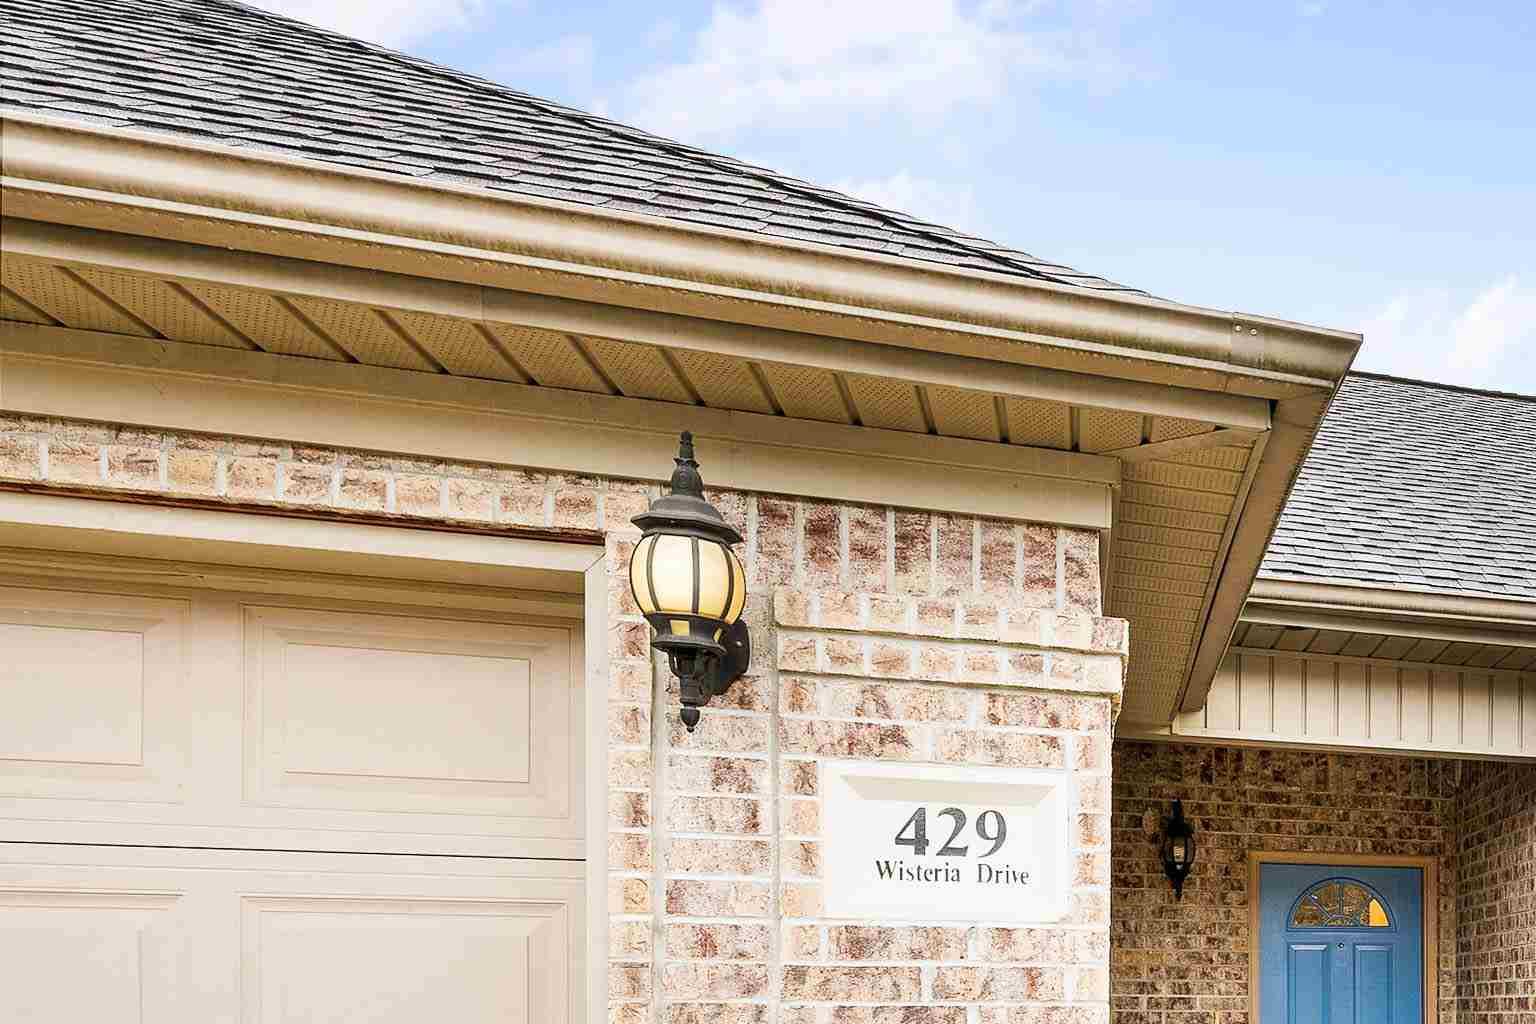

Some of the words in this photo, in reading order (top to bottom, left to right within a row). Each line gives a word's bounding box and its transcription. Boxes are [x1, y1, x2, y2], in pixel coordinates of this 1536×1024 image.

[894, 807, 1007, 857] 429
[875, 860, 961, 883] Wisteria
[977, 863, 1031, 885] Drive
